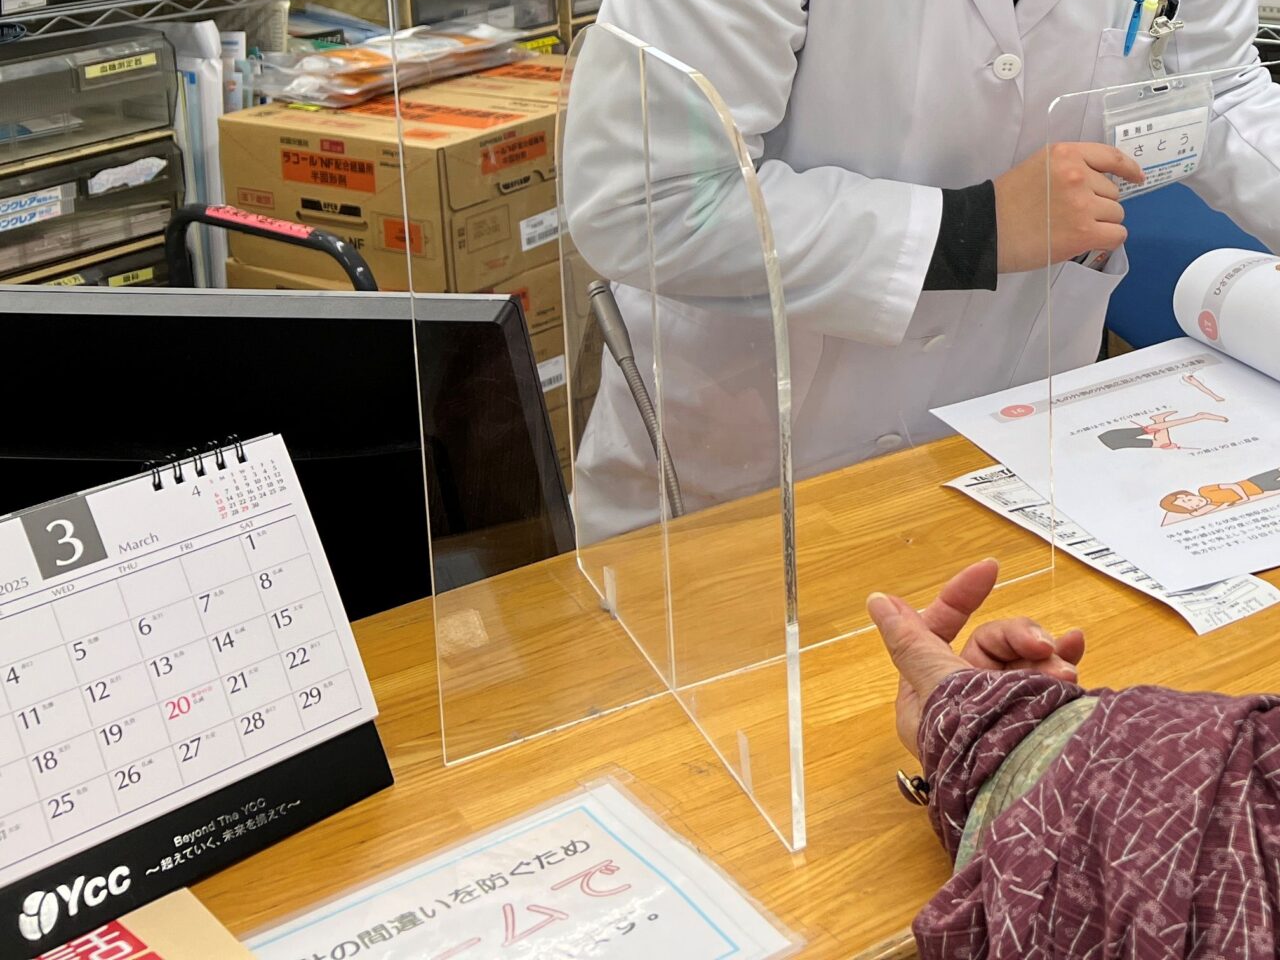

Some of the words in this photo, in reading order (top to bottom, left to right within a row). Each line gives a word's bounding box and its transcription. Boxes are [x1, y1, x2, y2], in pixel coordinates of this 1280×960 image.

[1133, 133, 1189, 157] さとう
[191, 485, 201, 497] 4
[46, 519, 84, 566] 3
[118, 532, 159, 554] March
[52, 583, 75, 597] WED
[118, 562, 138, 574] THU
[180, 542, 193, 552] FRI
[240, 521, 253, 531] SAT
[245, 534, 256, 550] 1
[6, 667, 20, 685] 4
[73, 641, 87, 661] 5
[139, 618, 152, 635] 6
[199, 594, 210, 613] 7
[260, 572, 272, 589] 8
[18, 707, 41, 730] 11
[85, 681, 110, 703] 12
[150, 657, 173, 677] 13
[212, 632, 234, 653] 14
[271, 609, 293, 629] 15
[33, 751, 57, 774] 18
[100, 724, 122, 746] 19
[166, 697, 191, 720] 20
[227, 672, 248, 694] 21
[286, 647, 310, 669] 22
[48, 793, 75, 819] 25
[115, 766, 141, 790] 26
[179, 737, 201, 762] 27
[241, 712, 265, 736] 28
[299, 687, 321, 709] 29
[173, 821, 215, 847] Beyond
[217, 812, 240, 828] The
[241, 797, 266, 815] YCC
